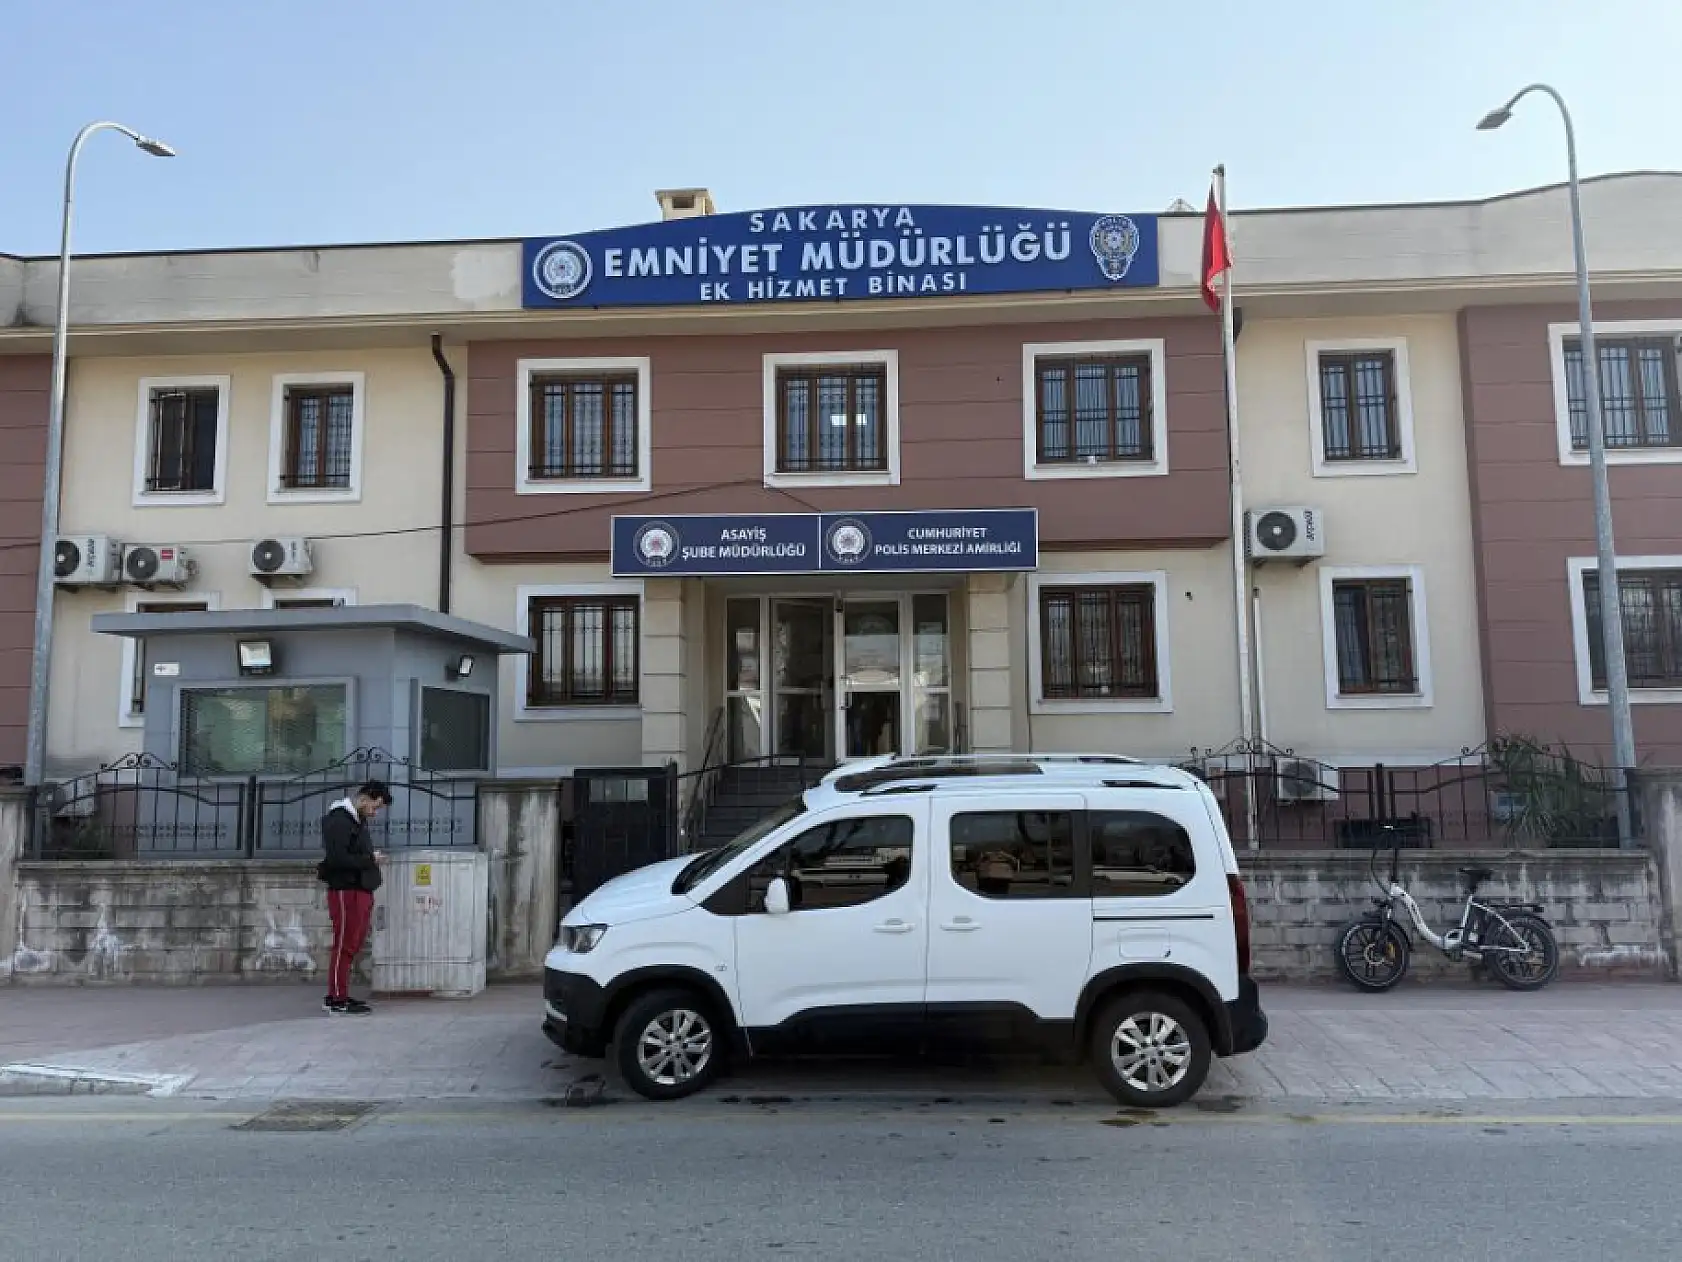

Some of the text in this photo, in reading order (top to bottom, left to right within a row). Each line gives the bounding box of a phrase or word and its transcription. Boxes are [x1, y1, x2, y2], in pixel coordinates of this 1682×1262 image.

[750, 207, 914, 233] SAKARYA
[604, 222, 1071, 277] EMNİYET MÜDÜRLÜĞÜ
[700, 271, 966, 300] EK HİZMET BİNASI
[721, 526, 767, 543] ASAYİŞ
[908, 526, 987, 539] CUMHURİYET
[682, 542, 805, 561] ŞUBE MÜDÜRLÜĞÜ
[874, 540, 1021, 555] POLİS MERKEZİ AMİRLİĞİ
